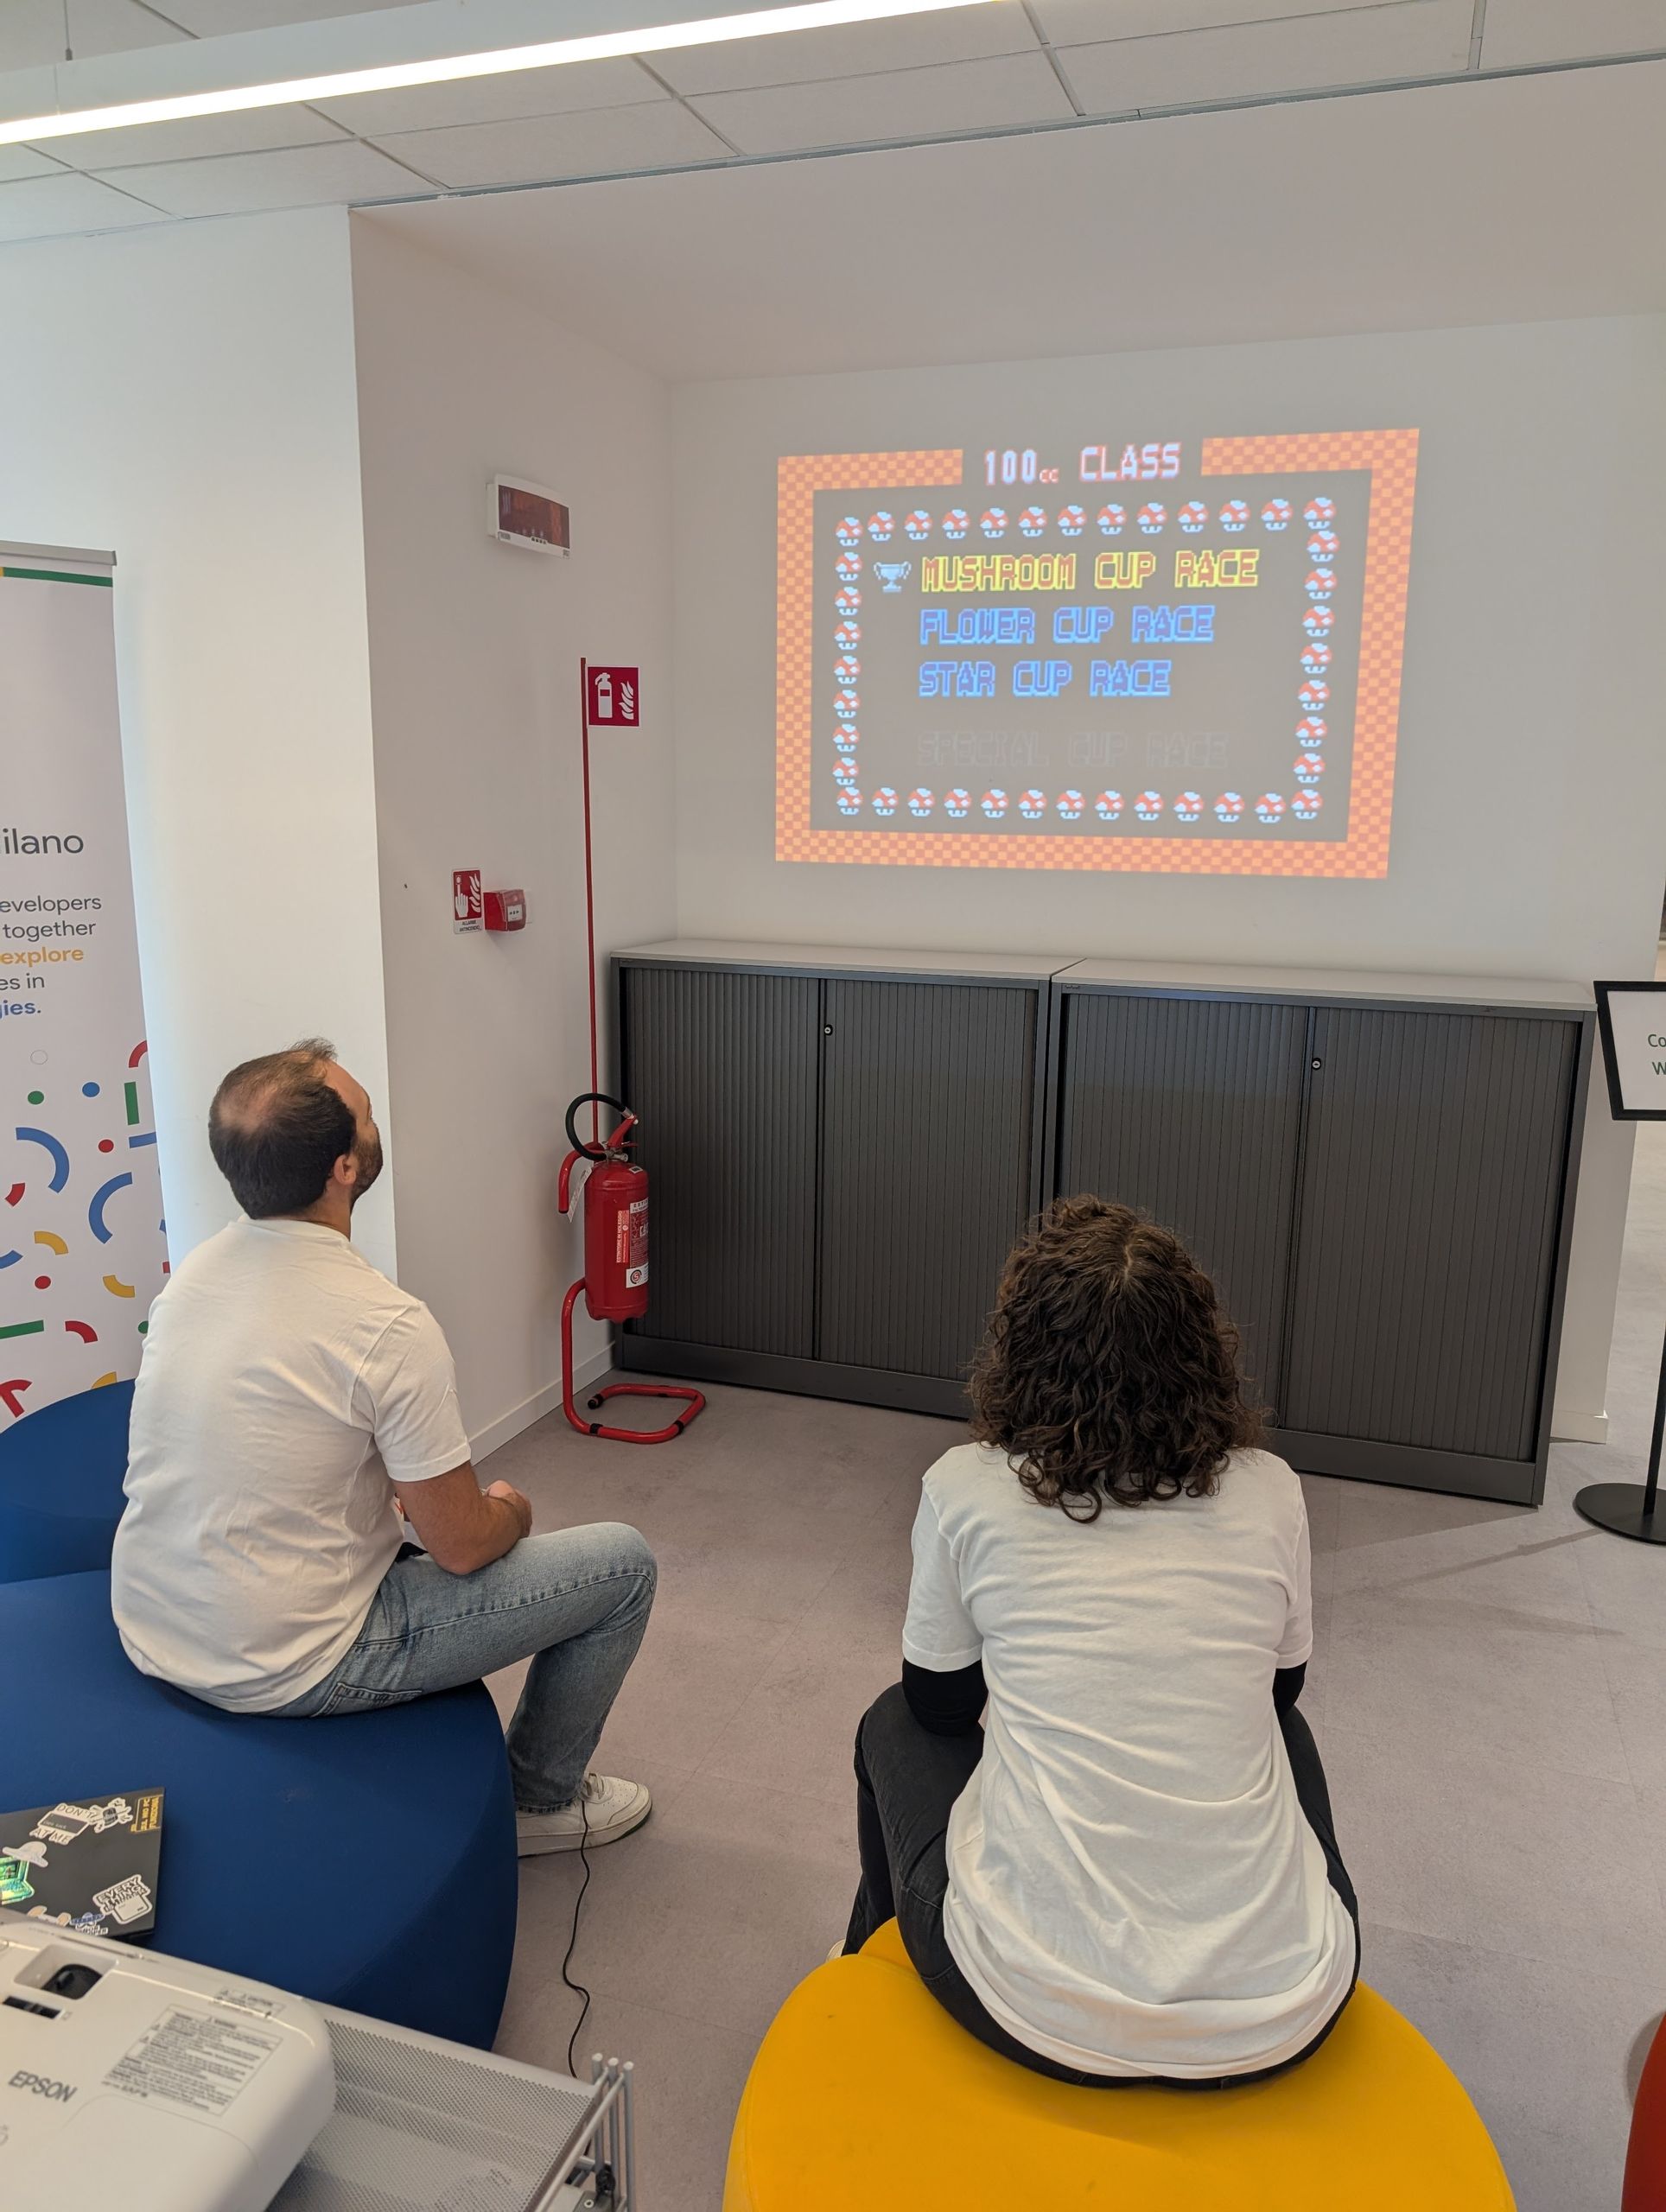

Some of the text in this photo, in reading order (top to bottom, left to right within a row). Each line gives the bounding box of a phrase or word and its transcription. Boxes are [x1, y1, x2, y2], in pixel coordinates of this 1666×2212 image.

[985, 442, 1181, 486] 100cc CLASS
[920, 549, 1260, 592] MUSHROOM CUP RACE
[919, 606, 1215, 645] FLOWER CUP RACE
[919, 659, 1172, 697] STAR CUP RACE
[917, 730, 1228, 769] SPECIAL CUP RACE
[0, 828, 85, 855] ilano
[3, 920, 97, 943] together
[0, 946, 85, 968] explore
[26, 972, 45, 989] in
[8, 2069, 78, 2103] EPSON
